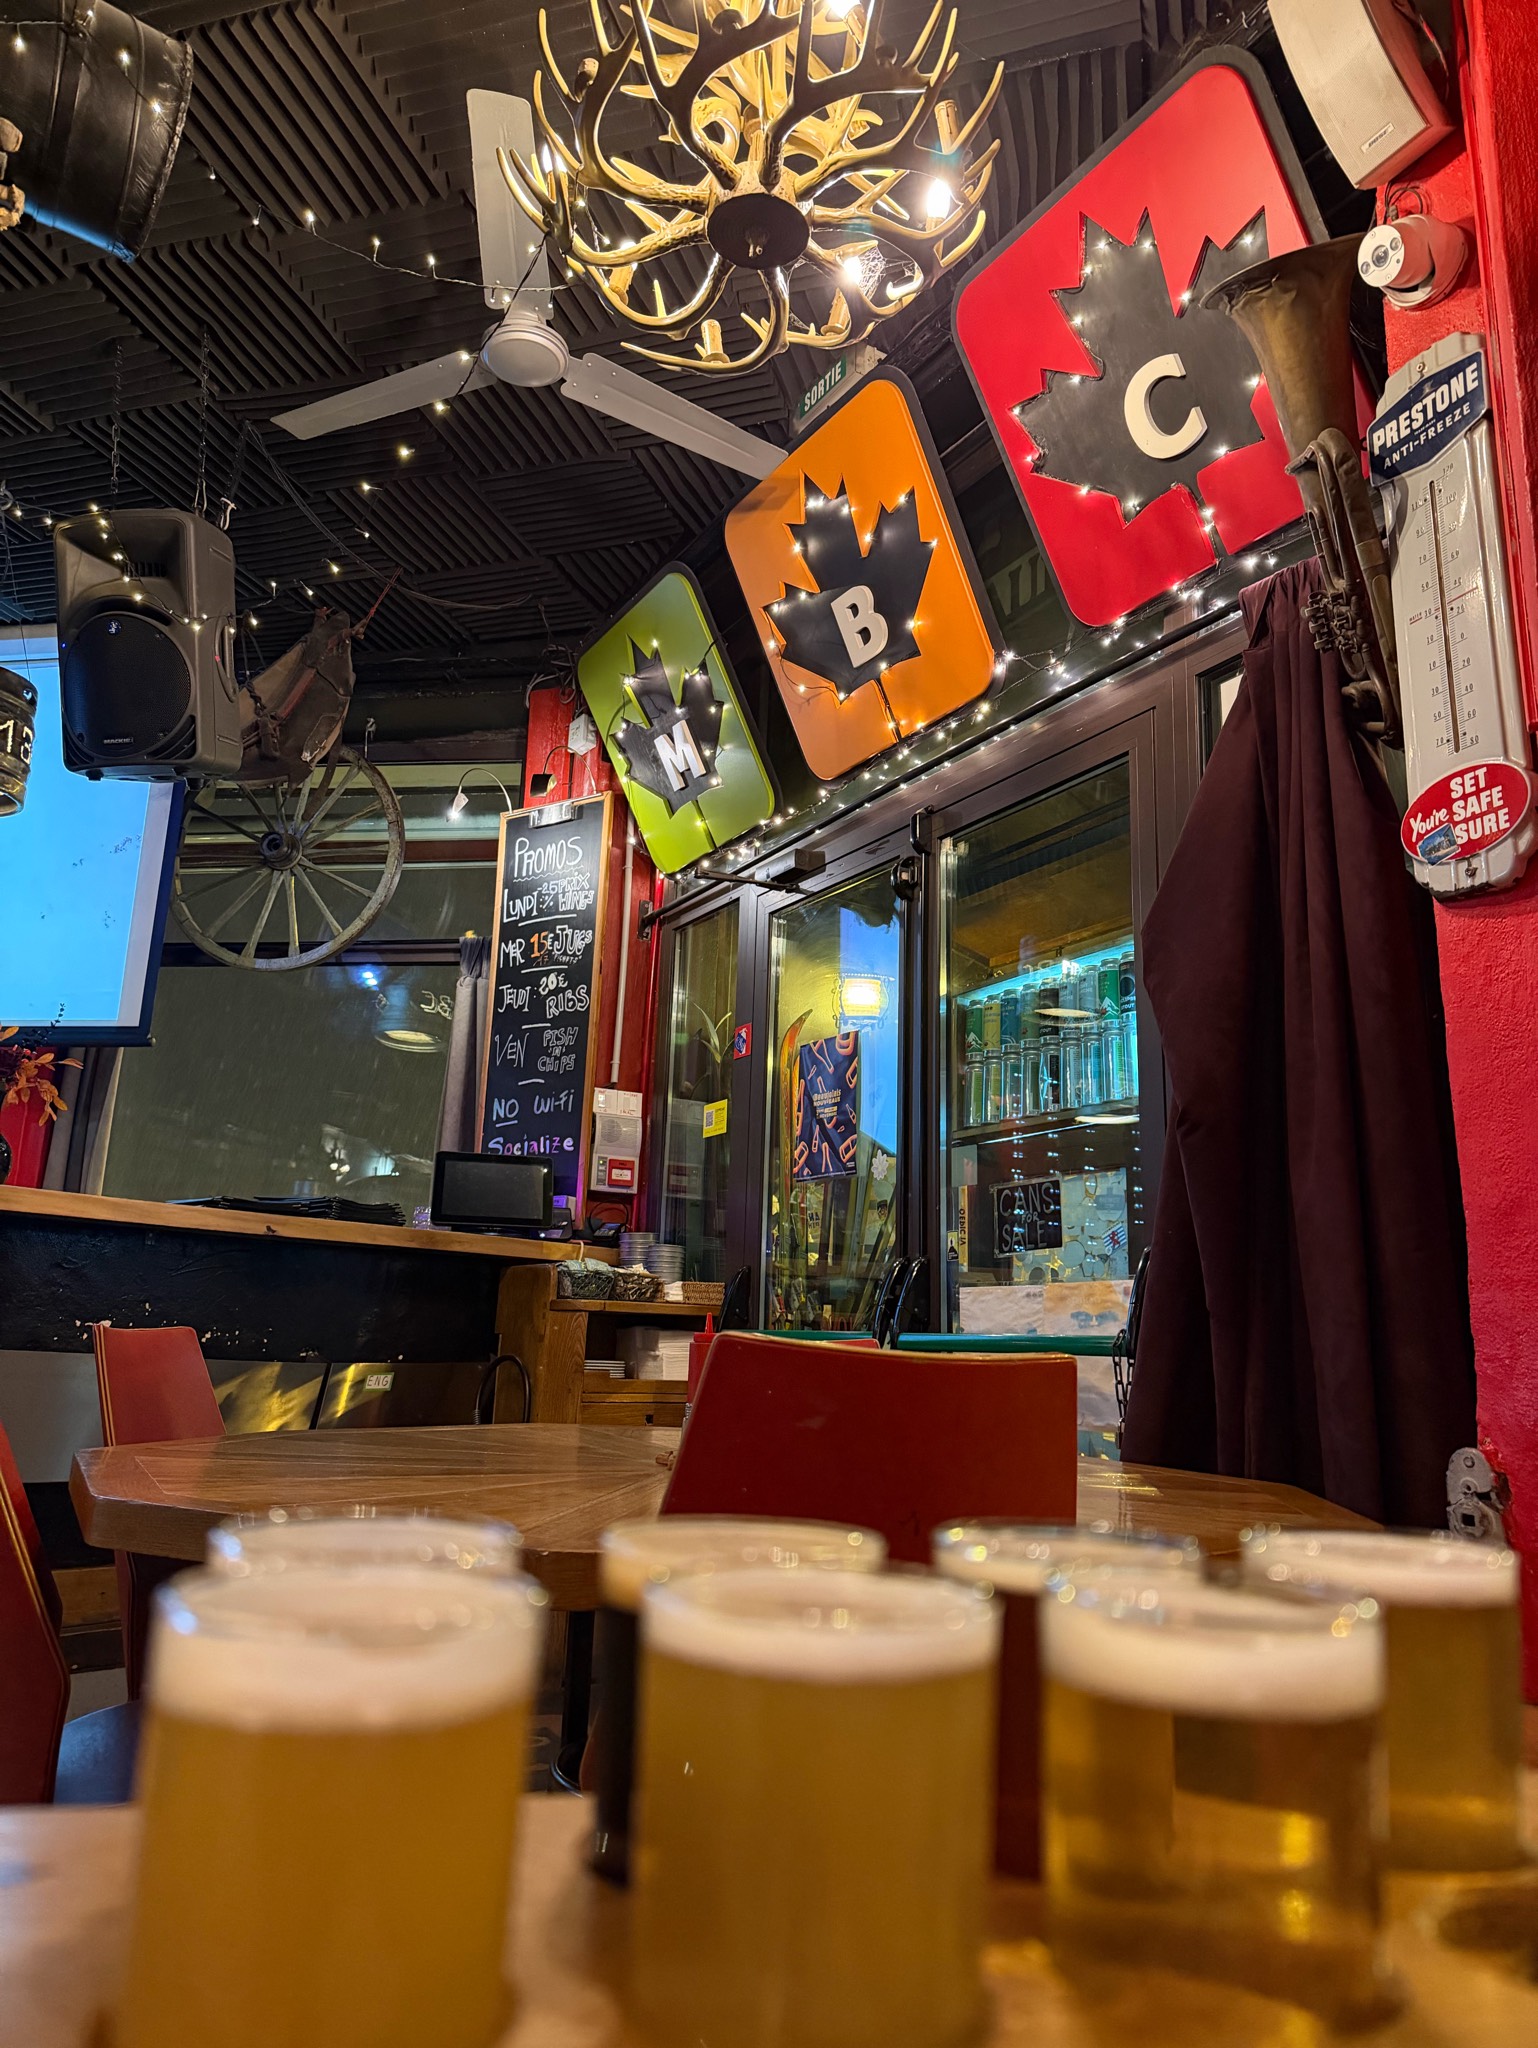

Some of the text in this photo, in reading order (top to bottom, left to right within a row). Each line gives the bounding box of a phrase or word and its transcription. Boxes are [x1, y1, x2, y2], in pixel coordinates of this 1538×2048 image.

[804, 361, 842, 412] SORTIE
[1124, 353, 1208, 459] C
[1372, 362, 1479, 457] PRESTONE
[1384, 402, 1471, 470] ANTI-FREEZE
[831, 585, 888, 668] B
[654, 719, 706, 792] M
[1450, 767, 1488, 799] SET
[1452, 785, 1504, 821] SAFE
[1410, 808, 1449, 842] You're
[1455, 808, 1510, 844] SURE
[514, 836, 584, 878] PROMOS
[538, 972, 568, 995] 20€
[546, 985, 590, 1019] RIBS
[495, 1026, 579, 1068] VEN FISH
[493, 1097, 519, 1122] NO
[488, 1133, 574, 1156] Socialize
[1000, 1182, 1054, 1217] CANS
[1021, 1211, 1040, 1223] FOR
[1002, 1220, 1048, 1252] SALE
[367, 1375, 389, 1387] ENG
